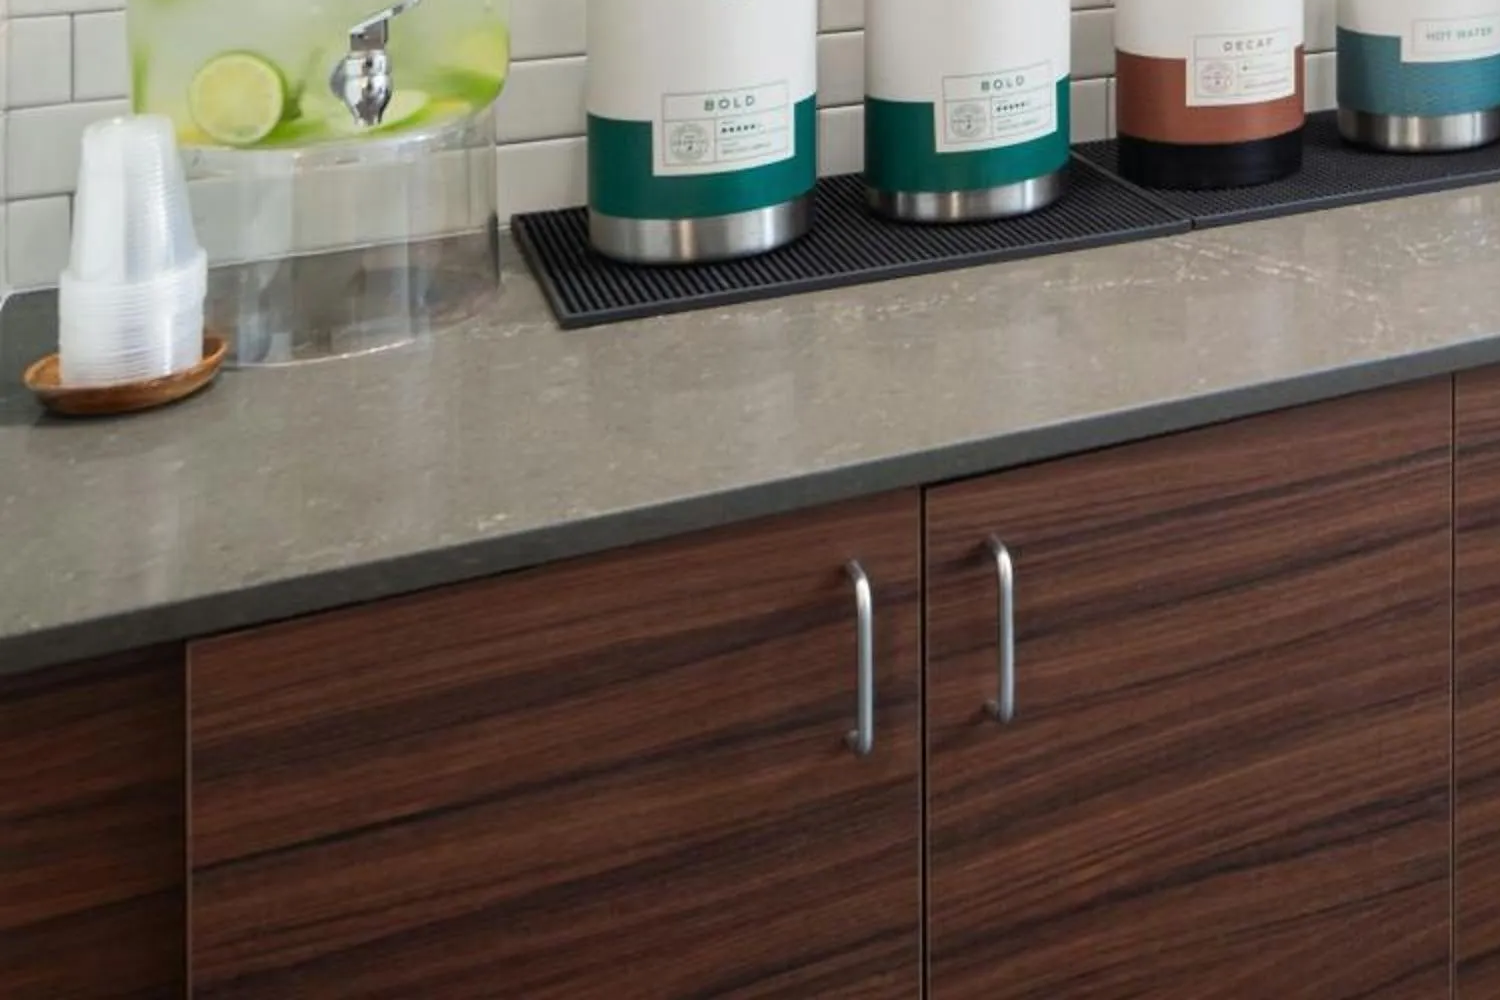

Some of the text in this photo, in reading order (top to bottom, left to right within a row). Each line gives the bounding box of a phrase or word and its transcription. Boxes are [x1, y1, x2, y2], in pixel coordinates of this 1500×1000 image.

[1223, 37, 1274, 52] DECAF
[981, 75, 1025, 91] BOLD
[704, 95, 756, 111] BOLD
